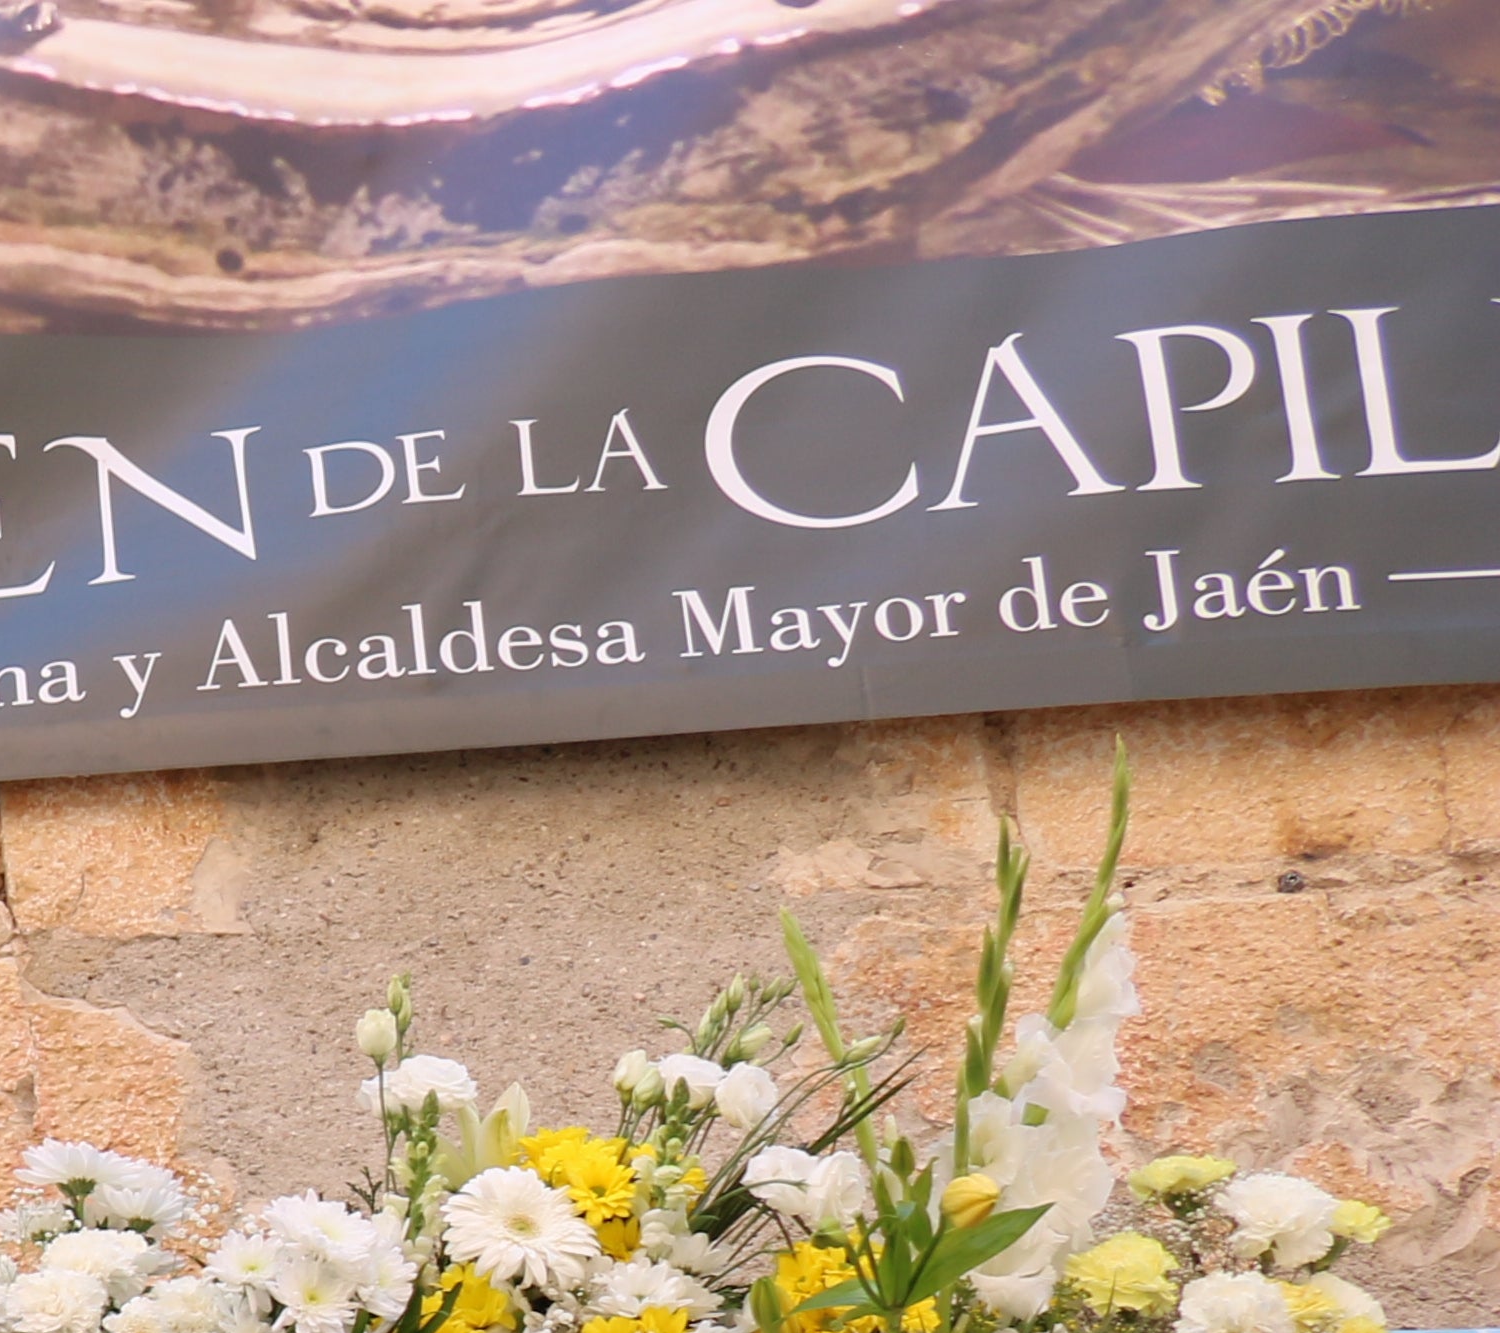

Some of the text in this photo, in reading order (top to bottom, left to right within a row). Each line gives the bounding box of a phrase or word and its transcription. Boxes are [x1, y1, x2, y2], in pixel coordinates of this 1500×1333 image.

[302, 429, 466, 518] DE
[508, 407, 668, 496] LA
[704, 298, 1500, 529] CAPIL
[113, 652, 162, 718] y
[196, 599, 646, 691] Alcaldesa
[671, 585, 966, 668] Mayor
[998, 555, 1110, 632] de
[1143, 548, 1362, 632] Jaén
